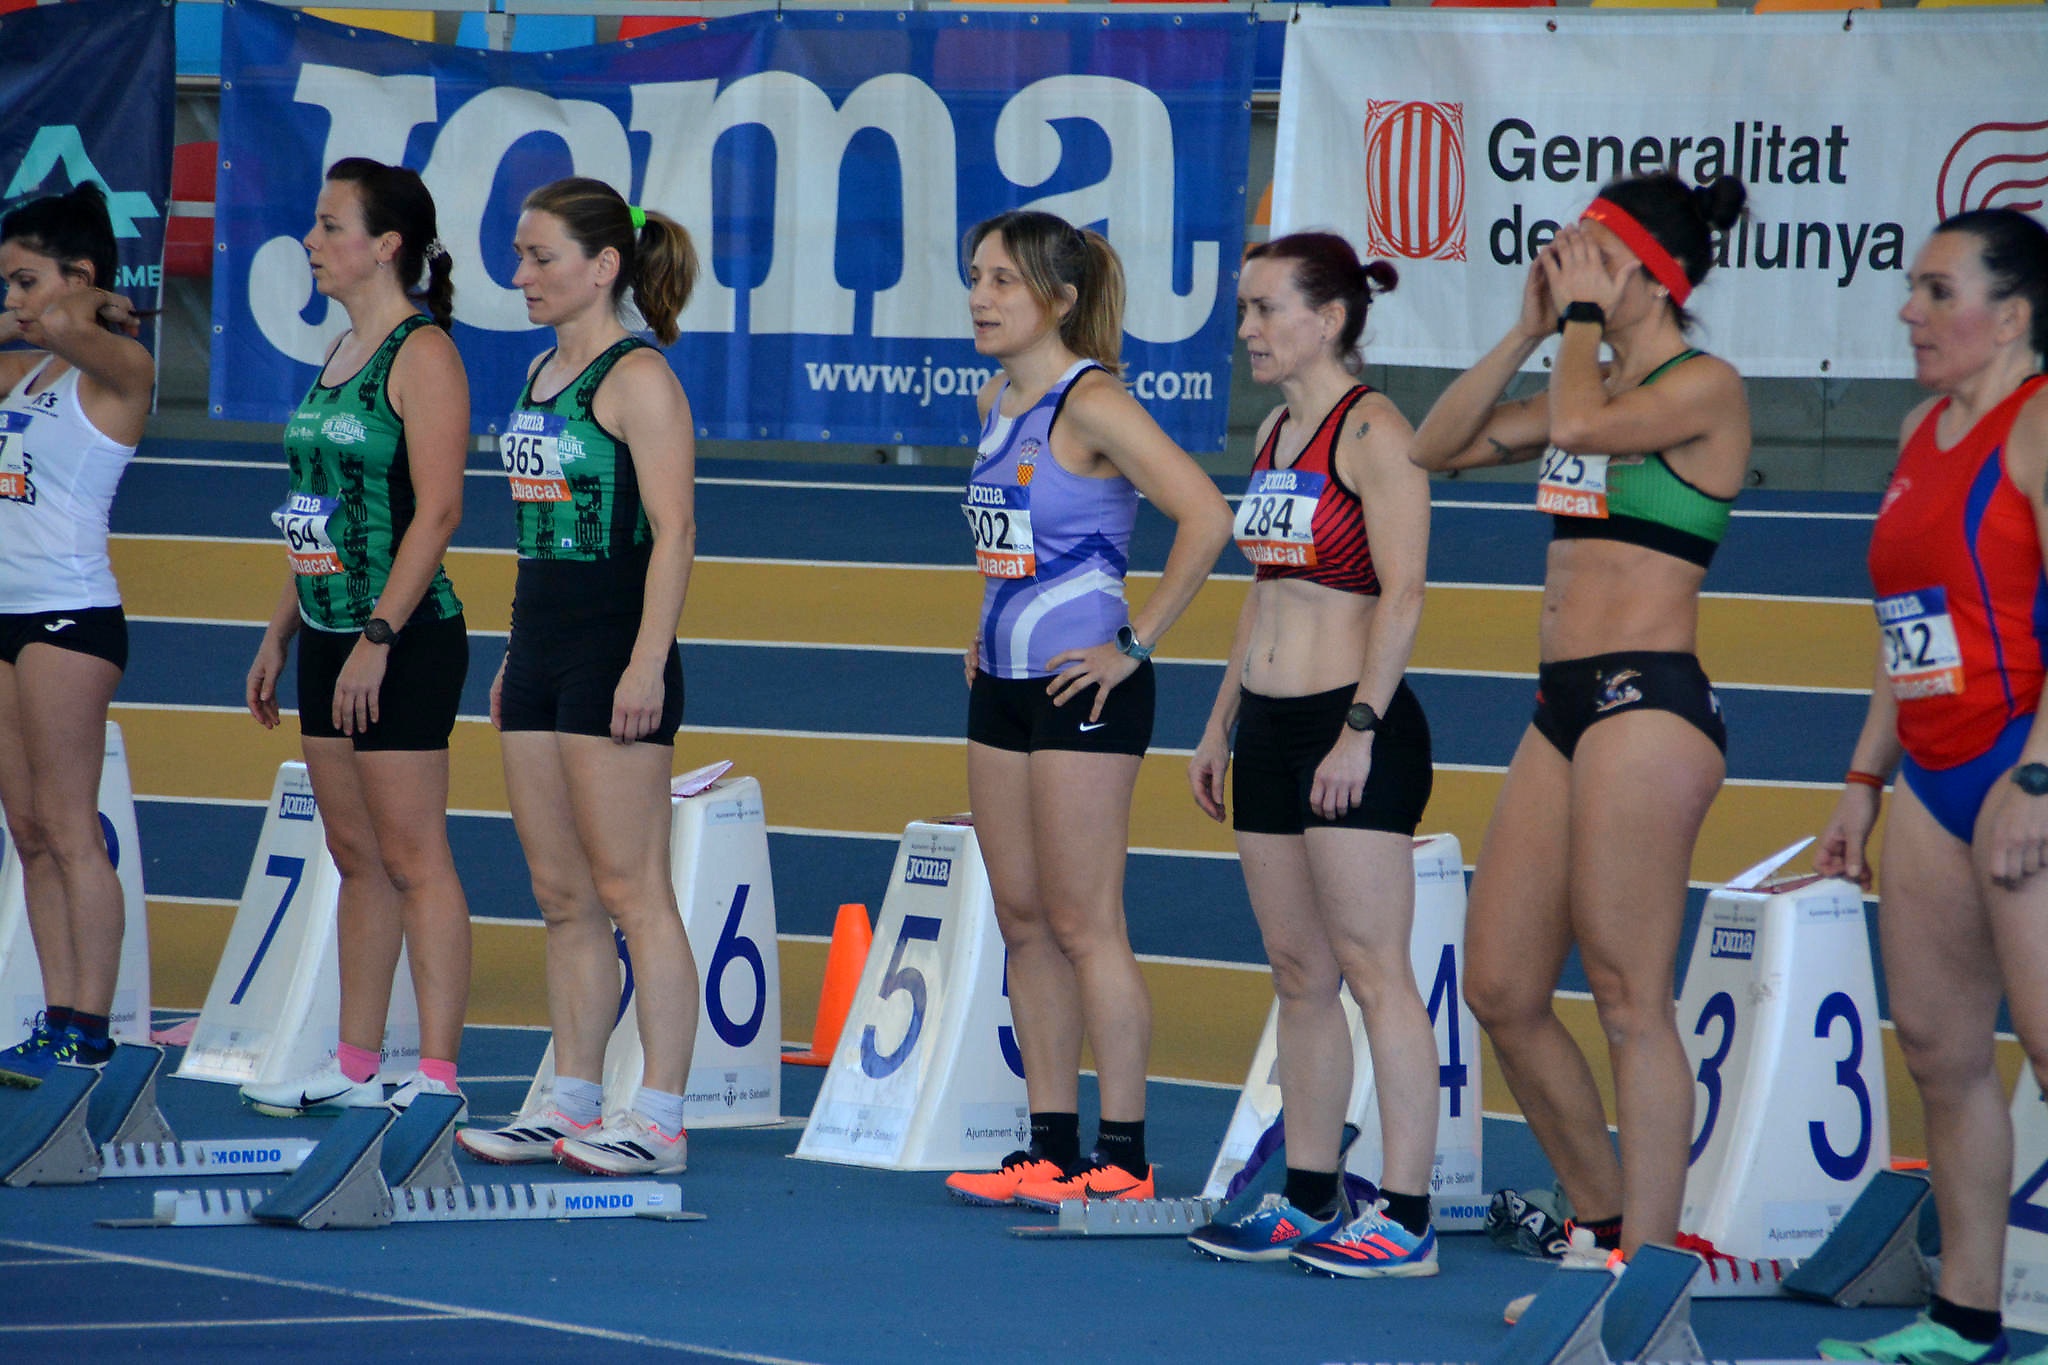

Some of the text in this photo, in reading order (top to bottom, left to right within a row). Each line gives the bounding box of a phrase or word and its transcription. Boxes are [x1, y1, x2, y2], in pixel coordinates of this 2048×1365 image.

[1488, 118, 1849, 184] Generalitat
[1490, 204, 1903, 287] de alunya
[505, 436, 544, 476] 365
[1244, 497, 1294, 538] 284
[906, 858, 949, 881] Joma
[230, 854, 305, 1005] 7
[705, 884, 766, 1048] 6
[860, 915, 942, 1080] 5
[1427, 944, 1467, 1117] 4
[1687, 992, 1736, 1169] 3
[1809, 992, 1872, 1182] 3
[212, 1149, 282, 1165] MONDO
[966, 1127, 1012, 1141] Ajuntament
[565, 1194, 634, 1210] MONDO
